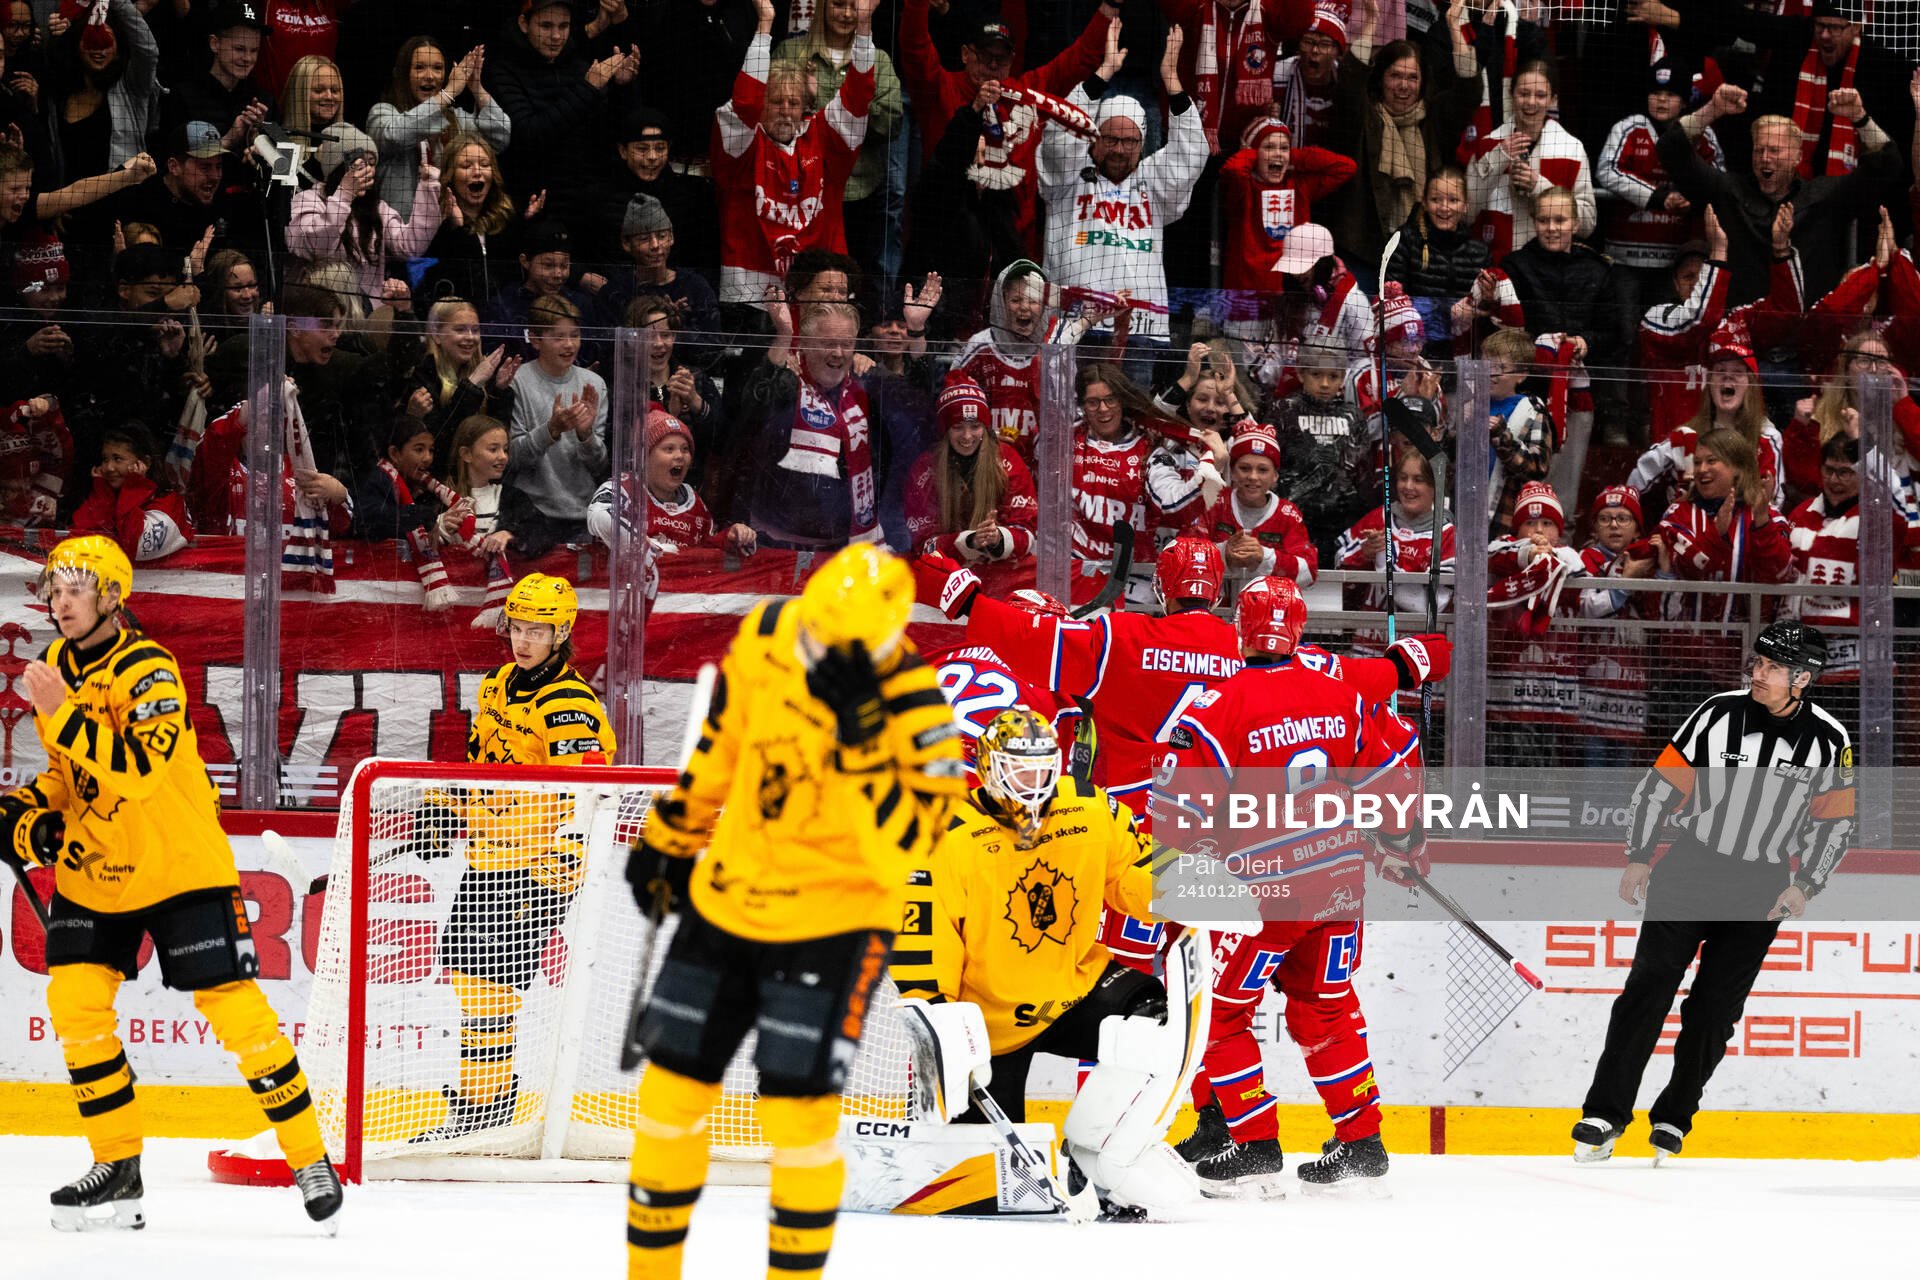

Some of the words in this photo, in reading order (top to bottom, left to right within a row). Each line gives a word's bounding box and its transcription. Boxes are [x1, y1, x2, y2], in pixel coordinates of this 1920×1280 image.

[243, 3, 256, 20] LA
[1087, 231, 1153, 253] PEAB
[1073, 488, 1148, 532] MRÅ
[1189, 583, 1204, 595] 41
[1268, 637, 1278, 650] 9
[1759, 636, 1774, 647] CCM
[1142, 647, 1246, 680] EISENMENG
[937, 662, 1018, 739] 92
[557, 740, 577, 755] SK
[1719, 753, 1748, 762] CCM
[1155, 752, 1178, 787] 9
[1775, 762, 1811, 782] SHL
[1054, 826, 1088, 842] skebo
[856, 1121, 911, 1140] CCM
